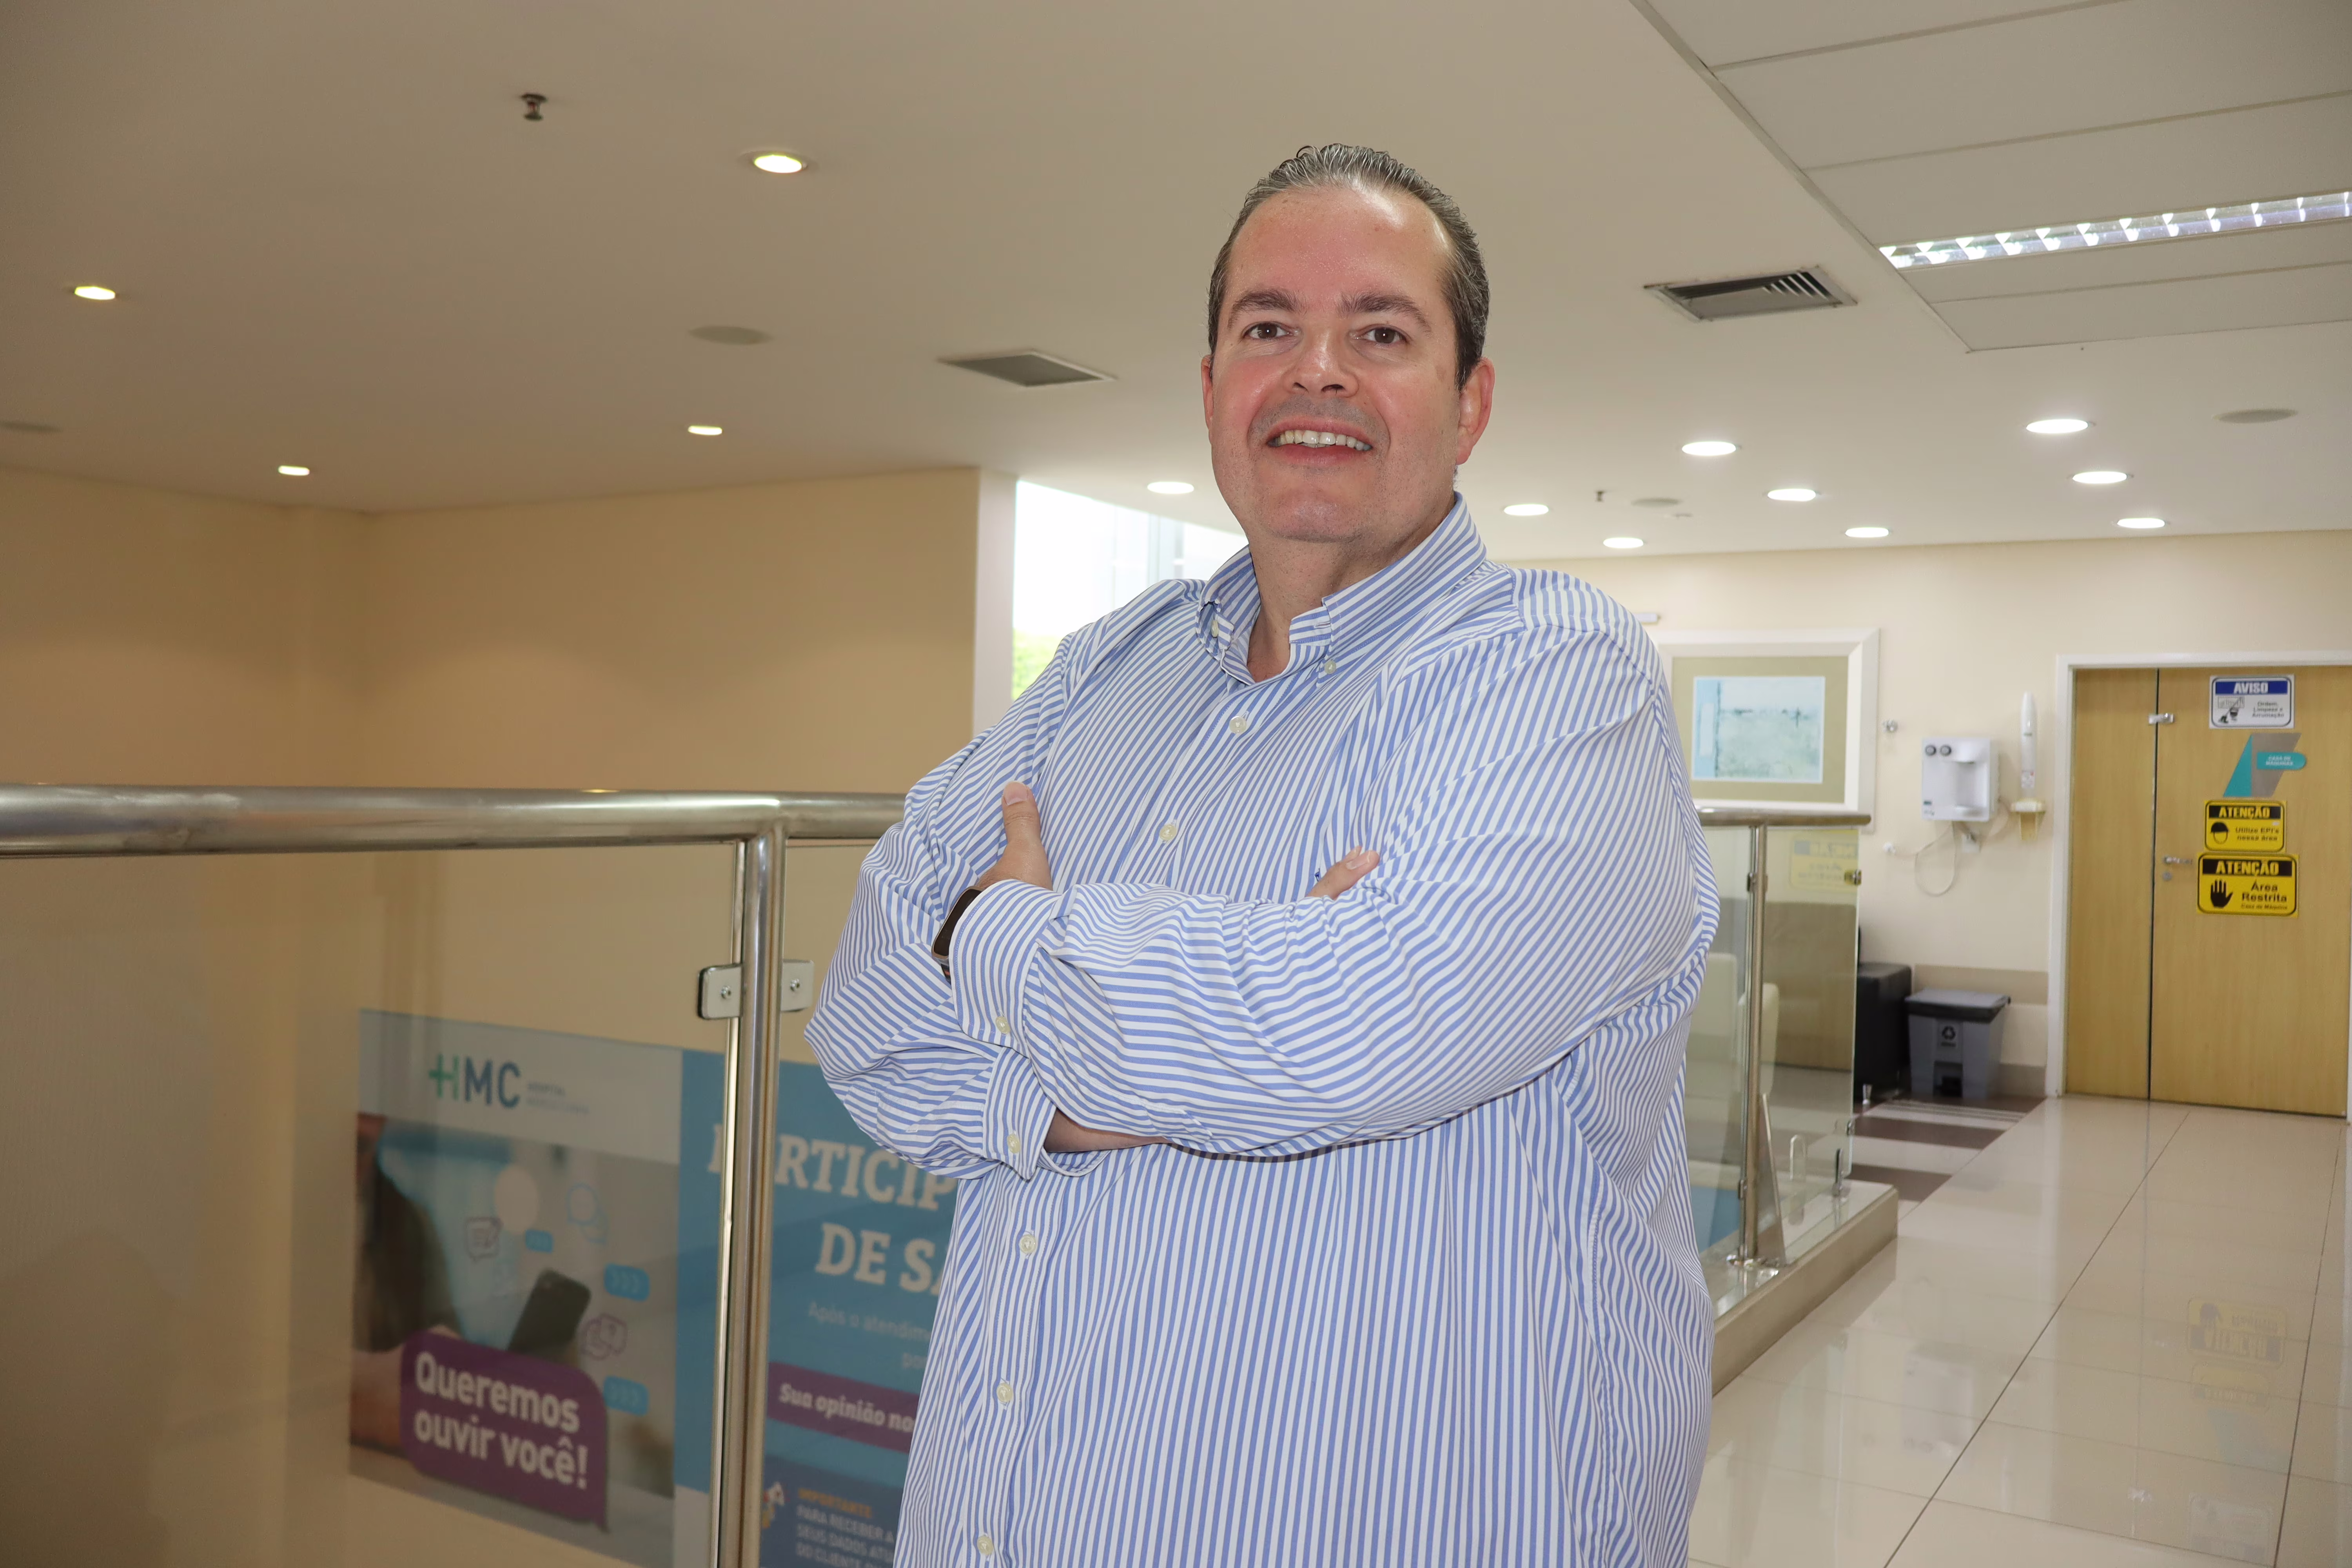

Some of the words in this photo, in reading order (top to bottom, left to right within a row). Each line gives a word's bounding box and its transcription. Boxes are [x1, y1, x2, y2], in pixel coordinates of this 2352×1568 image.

[2234, 682, 2269, 694] AVISO
[2219, 806, 2270, 819] ATENÇÃO
[2216, 860, 2279, 876] ATENÇÃO
[2251, 879, 2278, 891] Área
[2242, 892, 2287, 902] Restrita
[428, 1052, 521, 1109] HMC
[708, 1123, 957, 1210] RTICIP
[815, 1222, 891, 1285] DE
[899, 1238, 944, 1295] S
[415, 1351, 580, 1434] Queremos
[779, 1383, 813, 1409] Sua
[815, 1395, 886, 1426] opinião
[888, 1413, 915, 1433] no
[414, 1409, 496, 1461] ouvir
[499, 1432, 588, 1490] você!
